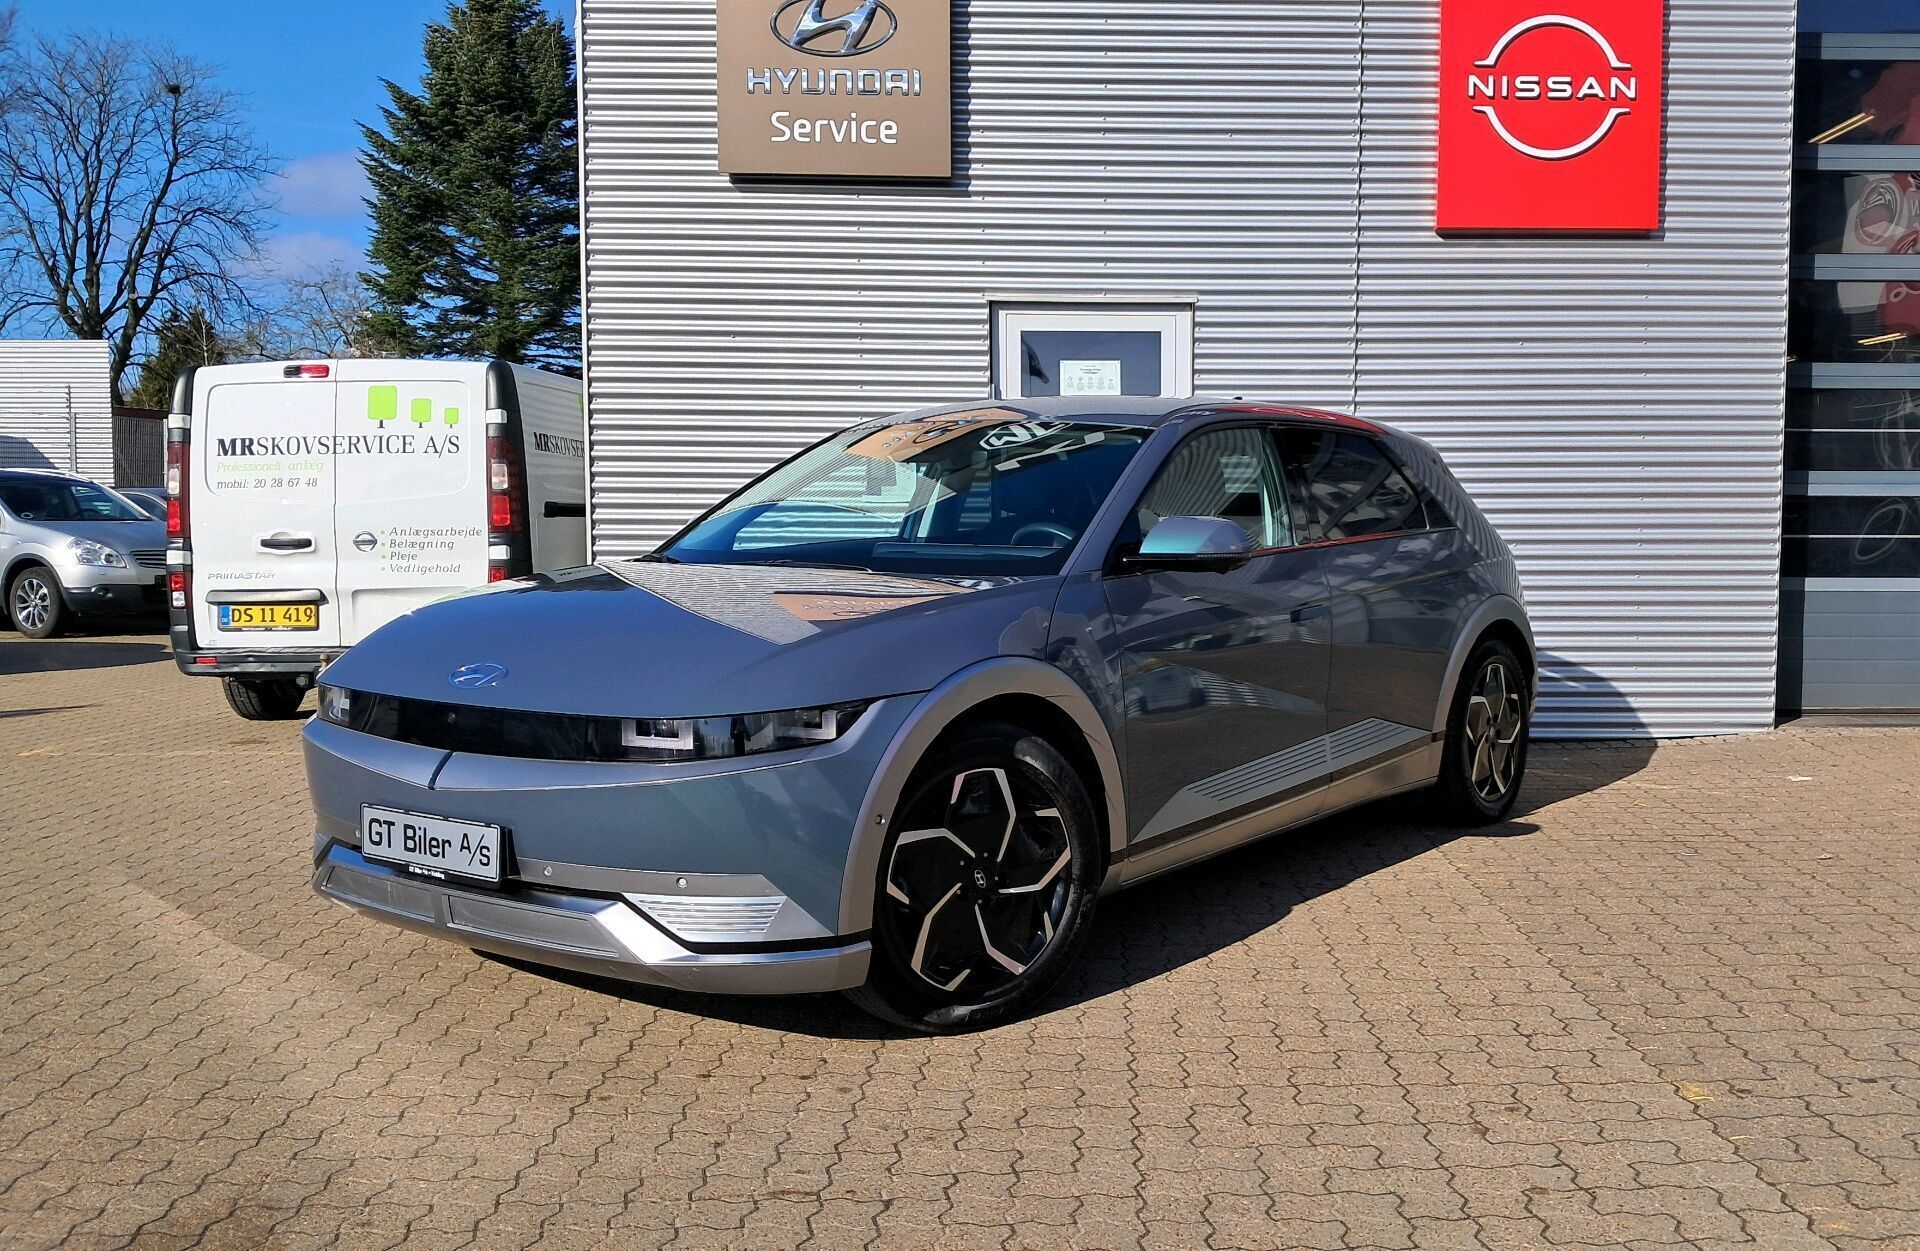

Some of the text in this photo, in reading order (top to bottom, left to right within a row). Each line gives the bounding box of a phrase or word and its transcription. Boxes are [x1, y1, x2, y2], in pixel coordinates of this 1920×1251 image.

[747, 67, 921, 96] HYUNDAI
[1467, 74, 1637, 100] NISSAN
[770, 111, 898, 144] Service
[216, 434, 460, 459] MRSKOVSERVICE A/S
[216, 477, 318, 489] mobil: 20 28 67 48
[389, 526, 483, 539] Anlægsarbejde
[389, 538, 455, 551] Belægning
[390, 551, 418, 562] Pleje
[207, 572, 275, 580] PRIMASTAR
[390, 563, 461, 575] Vedligehold
[231, 606, 315, 623] DS 11 419
[368, 817, 491, 867] GT Biler A/S
